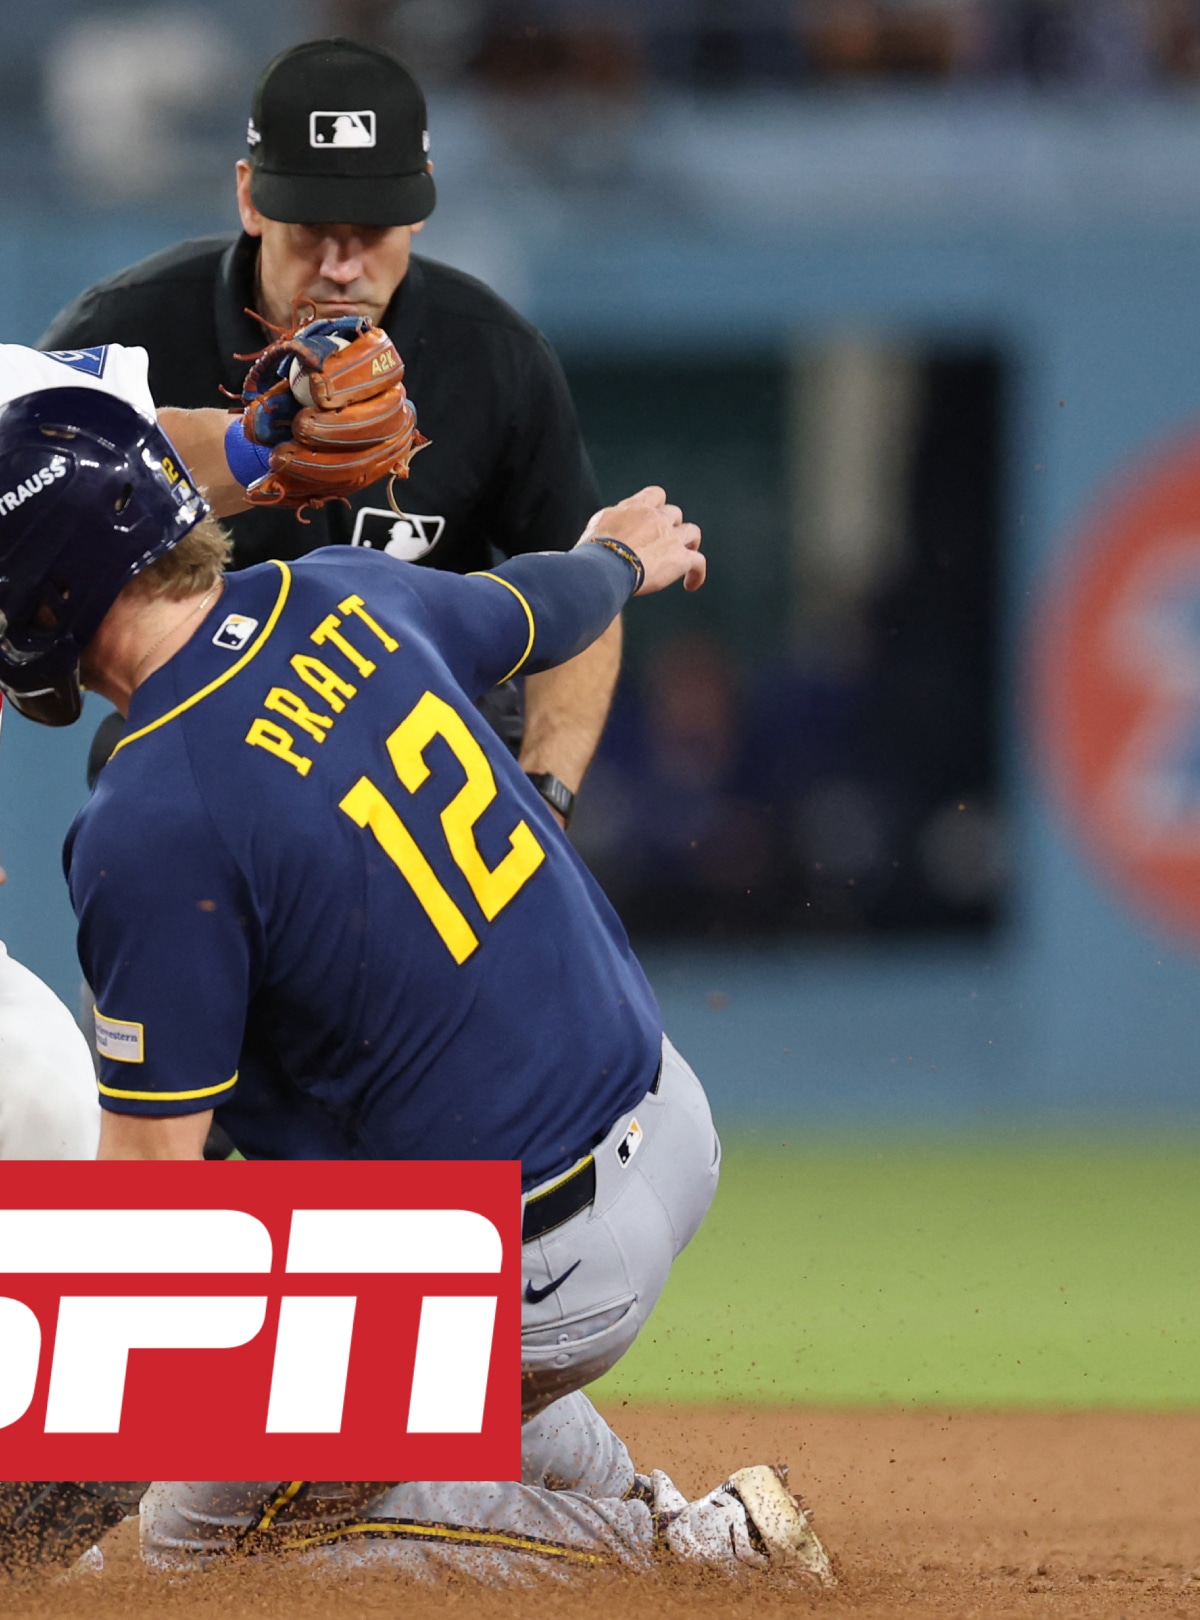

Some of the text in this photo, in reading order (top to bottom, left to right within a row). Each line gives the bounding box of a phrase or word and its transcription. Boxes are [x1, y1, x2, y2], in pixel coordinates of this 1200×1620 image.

[371, 349, 397, 377] A2K
[160, 456, 180, 486] 12
[244, 593, 401, 777] PRATT
[338, 690, 547, 966] 12
